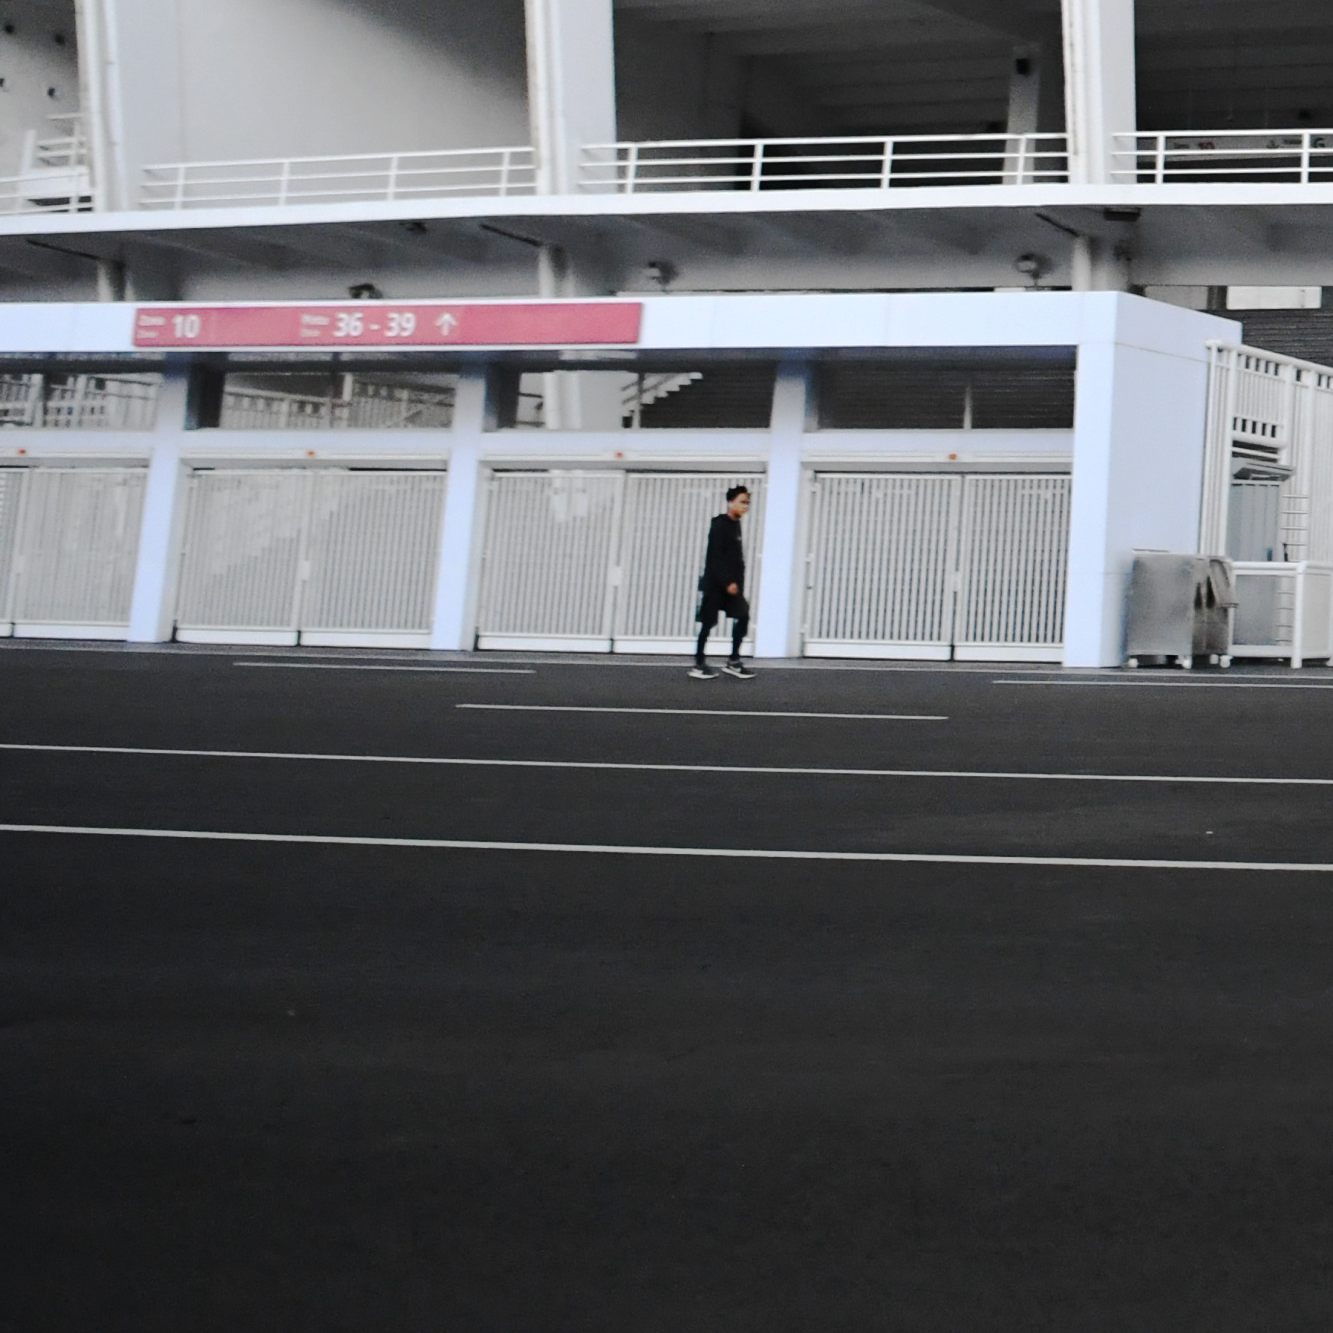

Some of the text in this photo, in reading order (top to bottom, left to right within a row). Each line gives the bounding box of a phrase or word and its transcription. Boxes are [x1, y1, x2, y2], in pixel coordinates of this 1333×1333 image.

[171, 313, 202, 339] 10
[333, 312, 364, 337] 36
[385, 312, 416, 337] 39
